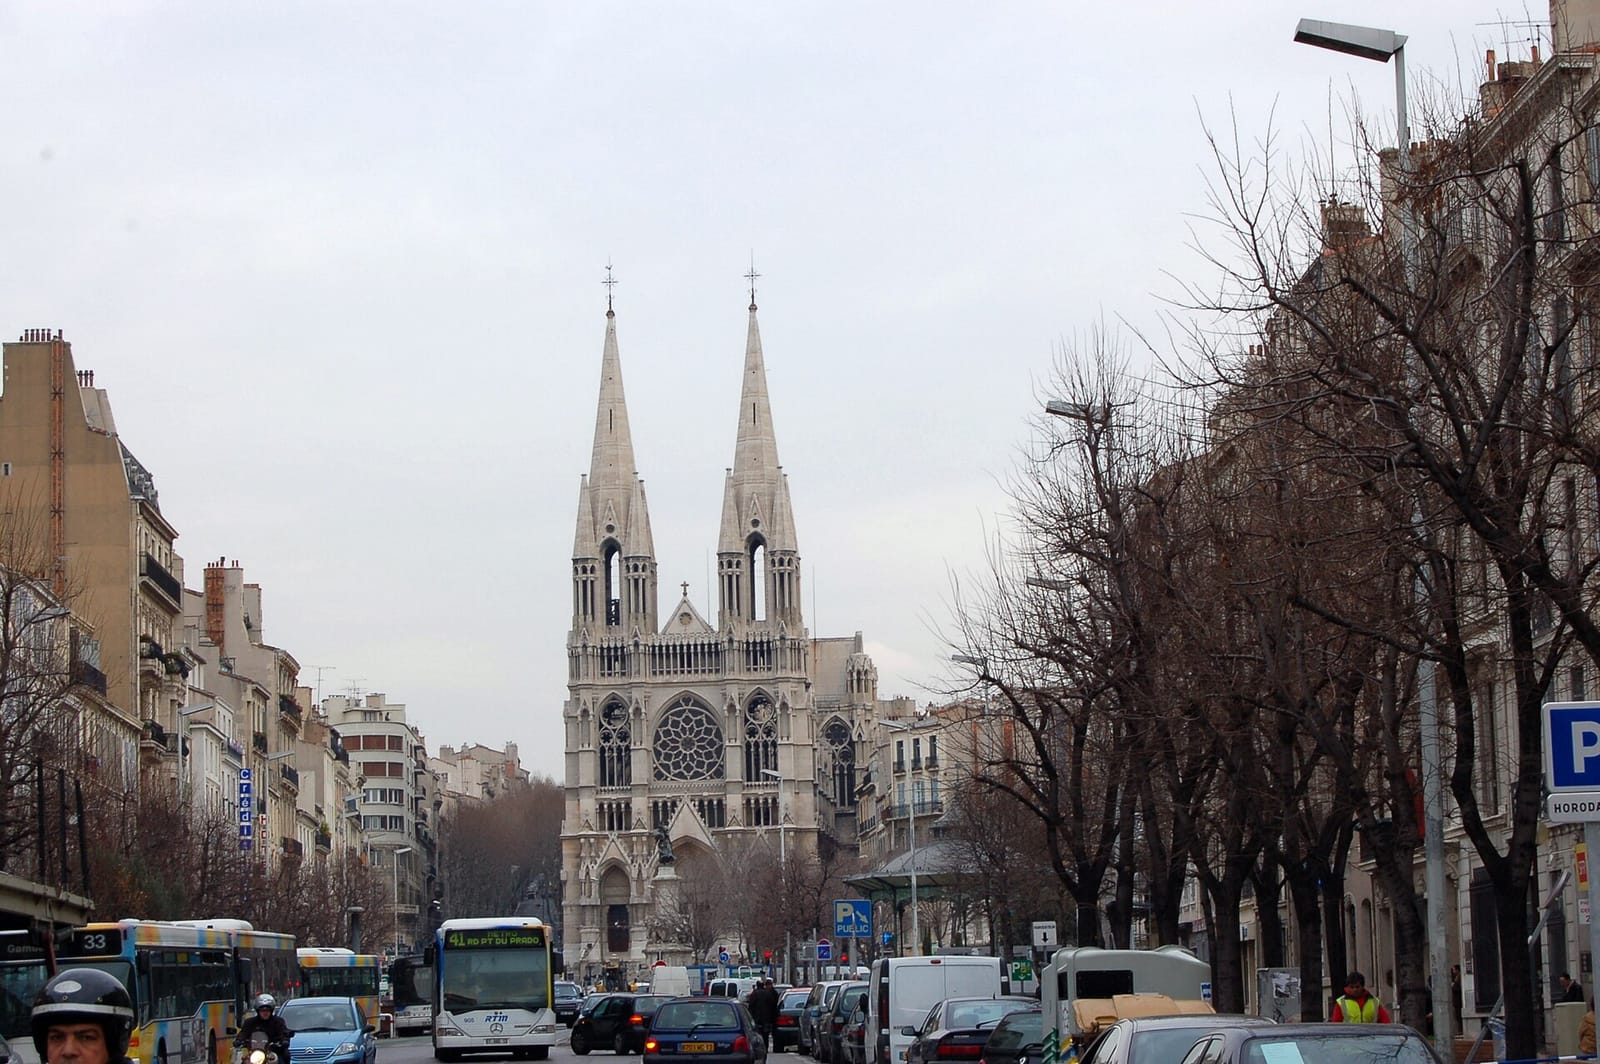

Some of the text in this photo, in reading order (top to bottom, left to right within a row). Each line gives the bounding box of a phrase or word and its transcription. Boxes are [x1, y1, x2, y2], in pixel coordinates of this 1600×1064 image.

[1571, 720, 1600, 774] P
[1554, 802, 1600, 813] HORODA
[837, 903, 854, 923] P
[84, 934, 106, 949] 33
[449, 932, 466, 946] 41
[495, 937, 508, 945] DU
